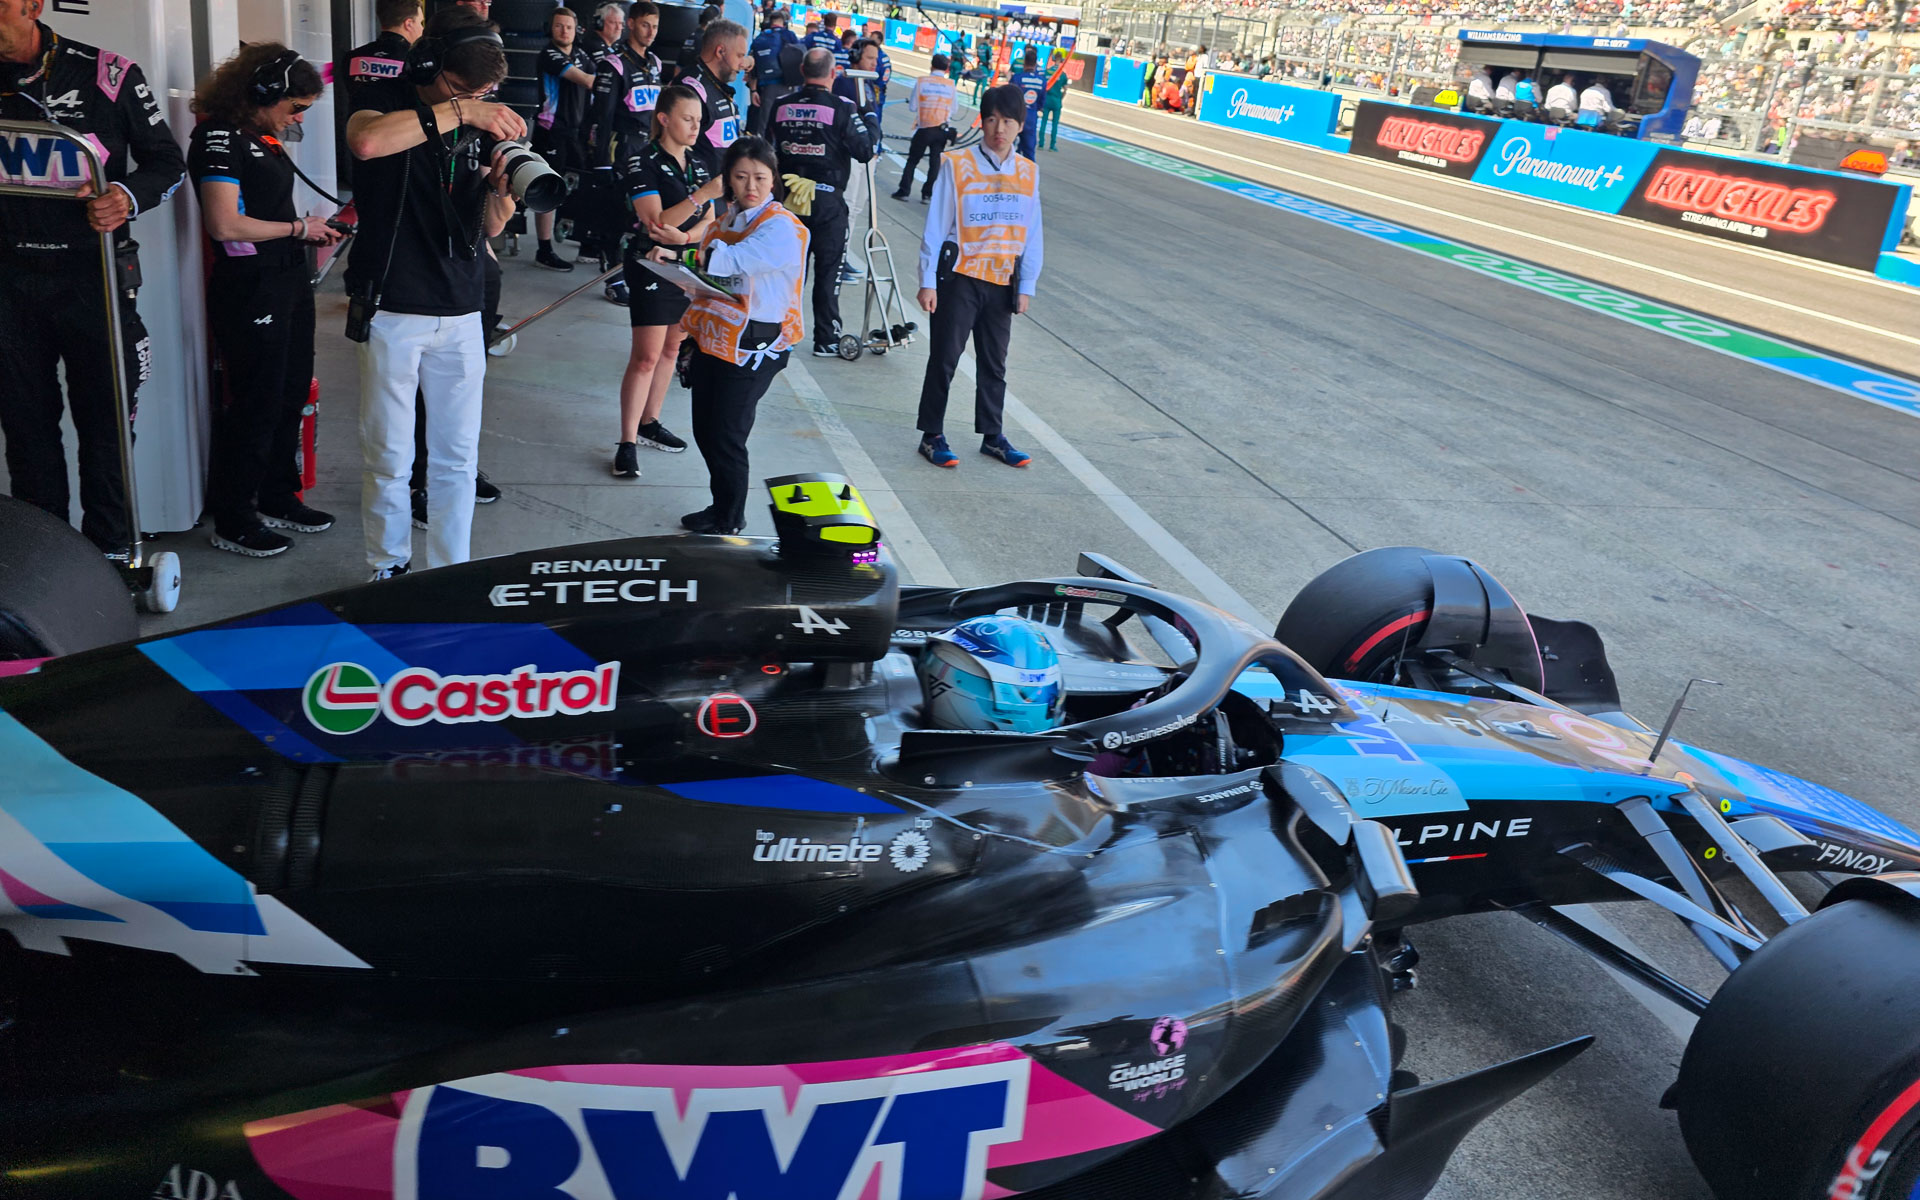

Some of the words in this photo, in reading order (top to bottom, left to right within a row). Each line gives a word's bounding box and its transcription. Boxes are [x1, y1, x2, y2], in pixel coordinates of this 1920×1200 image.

[370, 63, 399, 76] BWT
[795, 108, 817, 118] BWT
[1227, 88, 1294, 124] Paramount+
[790, 143, 825, 155] Castrol
[1378, 116, 1484, 161] KNUCKLES
[1493, 137, 1625, 191] Paramount+
[1648, 167, 1834, 231] KNUCKLES
[1681, 211, 1728, 229] STREAMING
[530, 558, 667, 575] RENAULT
[488, 579, 699, 607] E-TECH
[387, 665, 616, 722] Castrol
[711, 698, 741, 737] E
[1122, 713, 1200, 745] businessolver
[1196, 784, 1251, 803] BINANCE
[1299, 766, 1356, 825] ALPIN
[756, 829, 775, 844] bp
[915, 817, 933, 831] bp
[1396, 817, 1533, 847] LPINE
[753, 837, 883, 862] ultimate
[1811, 840, 1895, 873] FINOX
[1109, 1054, 1187, 1083] CHANGE
[1124, 1068, 1185, 1092] WORLD
[414, 1076, 1014, 1200] BWT
